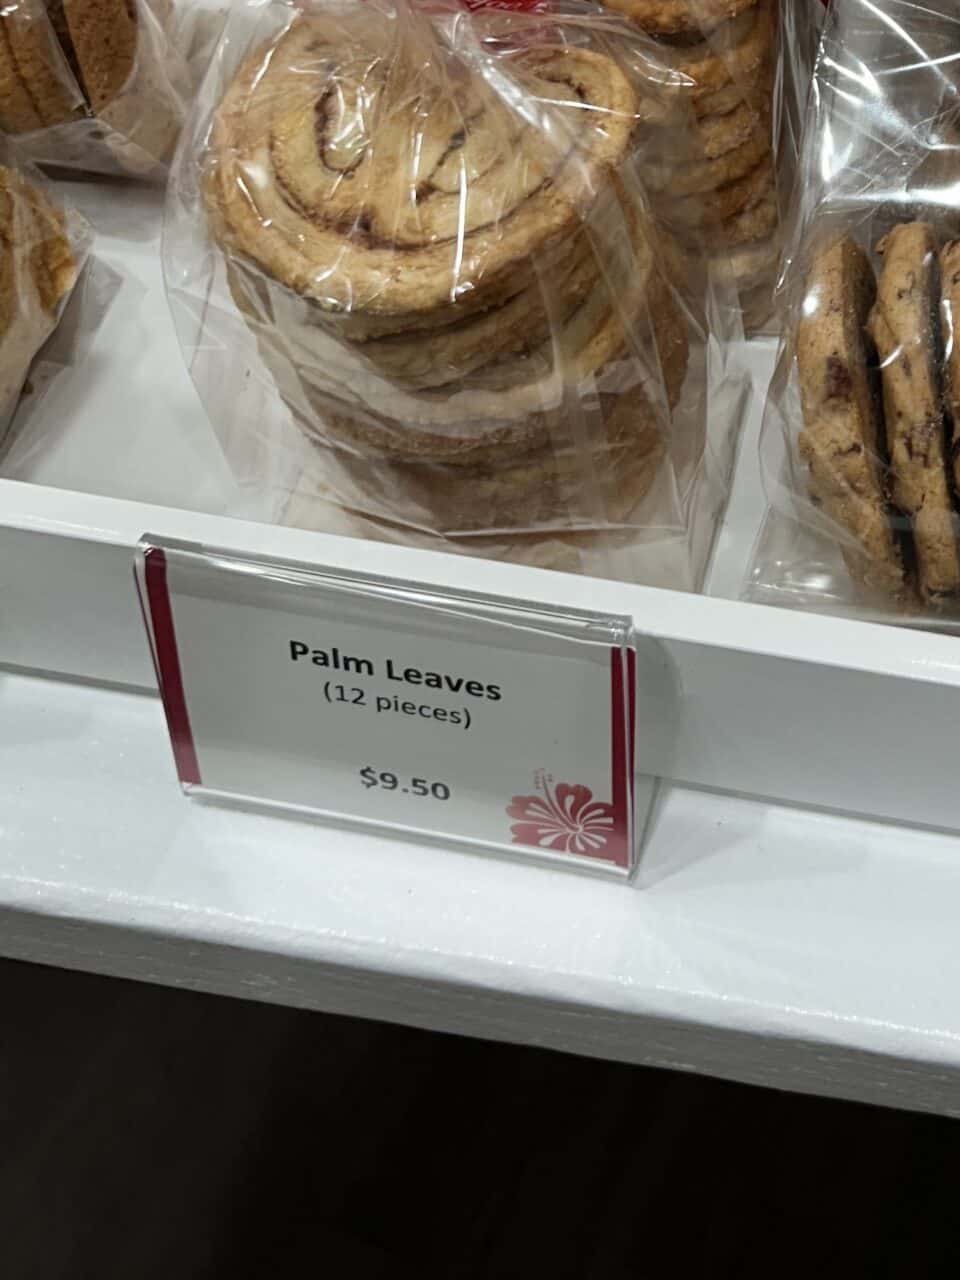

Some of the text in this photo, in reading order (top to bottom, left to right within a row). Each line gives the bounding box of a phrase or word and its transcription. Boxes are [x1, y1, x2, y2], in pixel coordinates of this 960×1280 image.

[289, 639, 503, 701] Palm Leaves
[323, 681, 473, 730] (12 pieces)
[358, 765, 452, 803] $9.50
